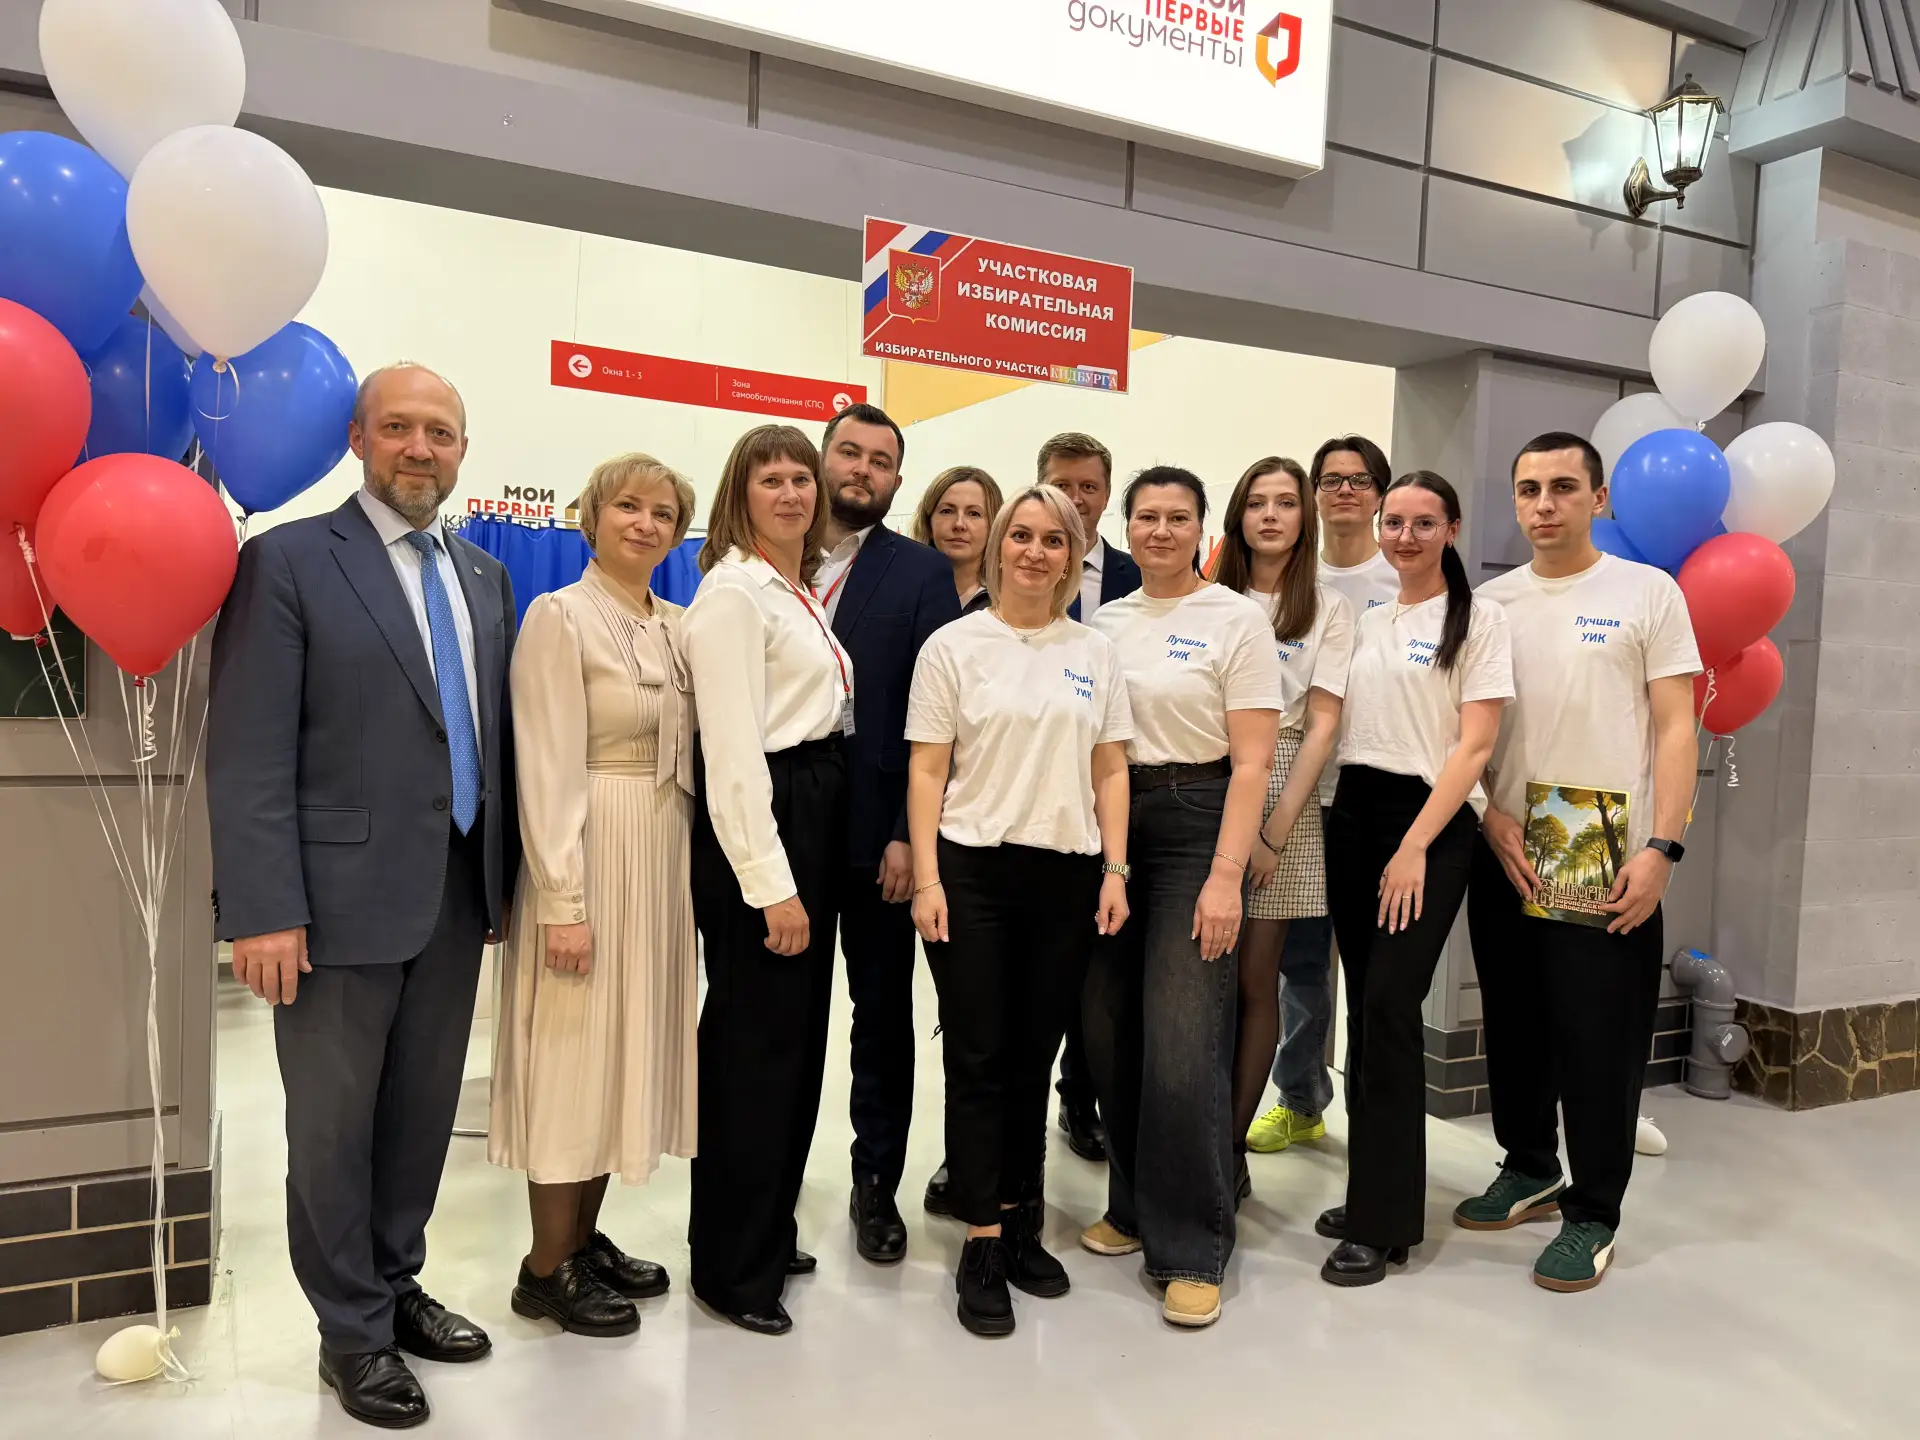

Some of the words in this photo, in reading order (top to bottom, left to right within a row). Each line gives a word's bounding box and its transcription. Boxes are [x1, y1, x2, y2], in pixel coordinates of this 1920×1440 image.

[1068, 0, 1243, 67] документы
[977, 257, 1098, 293] УЧАСТКОВАЯ
[957, 281, 1114, 322] ИЗБИРАТЕЛЬНАЯ
[986, 313, 1086, 343] КОМИССИЯ
[875, 341, 992, 368] ИЗБИРАТЕЛЬНОГО
[995, 360, 1049, 377] УЧАСТКА
[602, 366, 623, 377] Окна
[732, 379, 751, 389] Зона
[731, 390, 803, 406] самообслуживания
[804, 400, 825, 411] (СПС)
[504, 485, 555, 503] МОИ
[1574, 616, 1620, 628] Лучшая
[1166, 634, 1207, 649] Лучшая
[1407, 639, 1442, 651] Лучша
[1581, 632, 1607, 644] УИК
[1167, 649, 1190, 661] УИК
[1407, 652, 1432, 666] УИК
